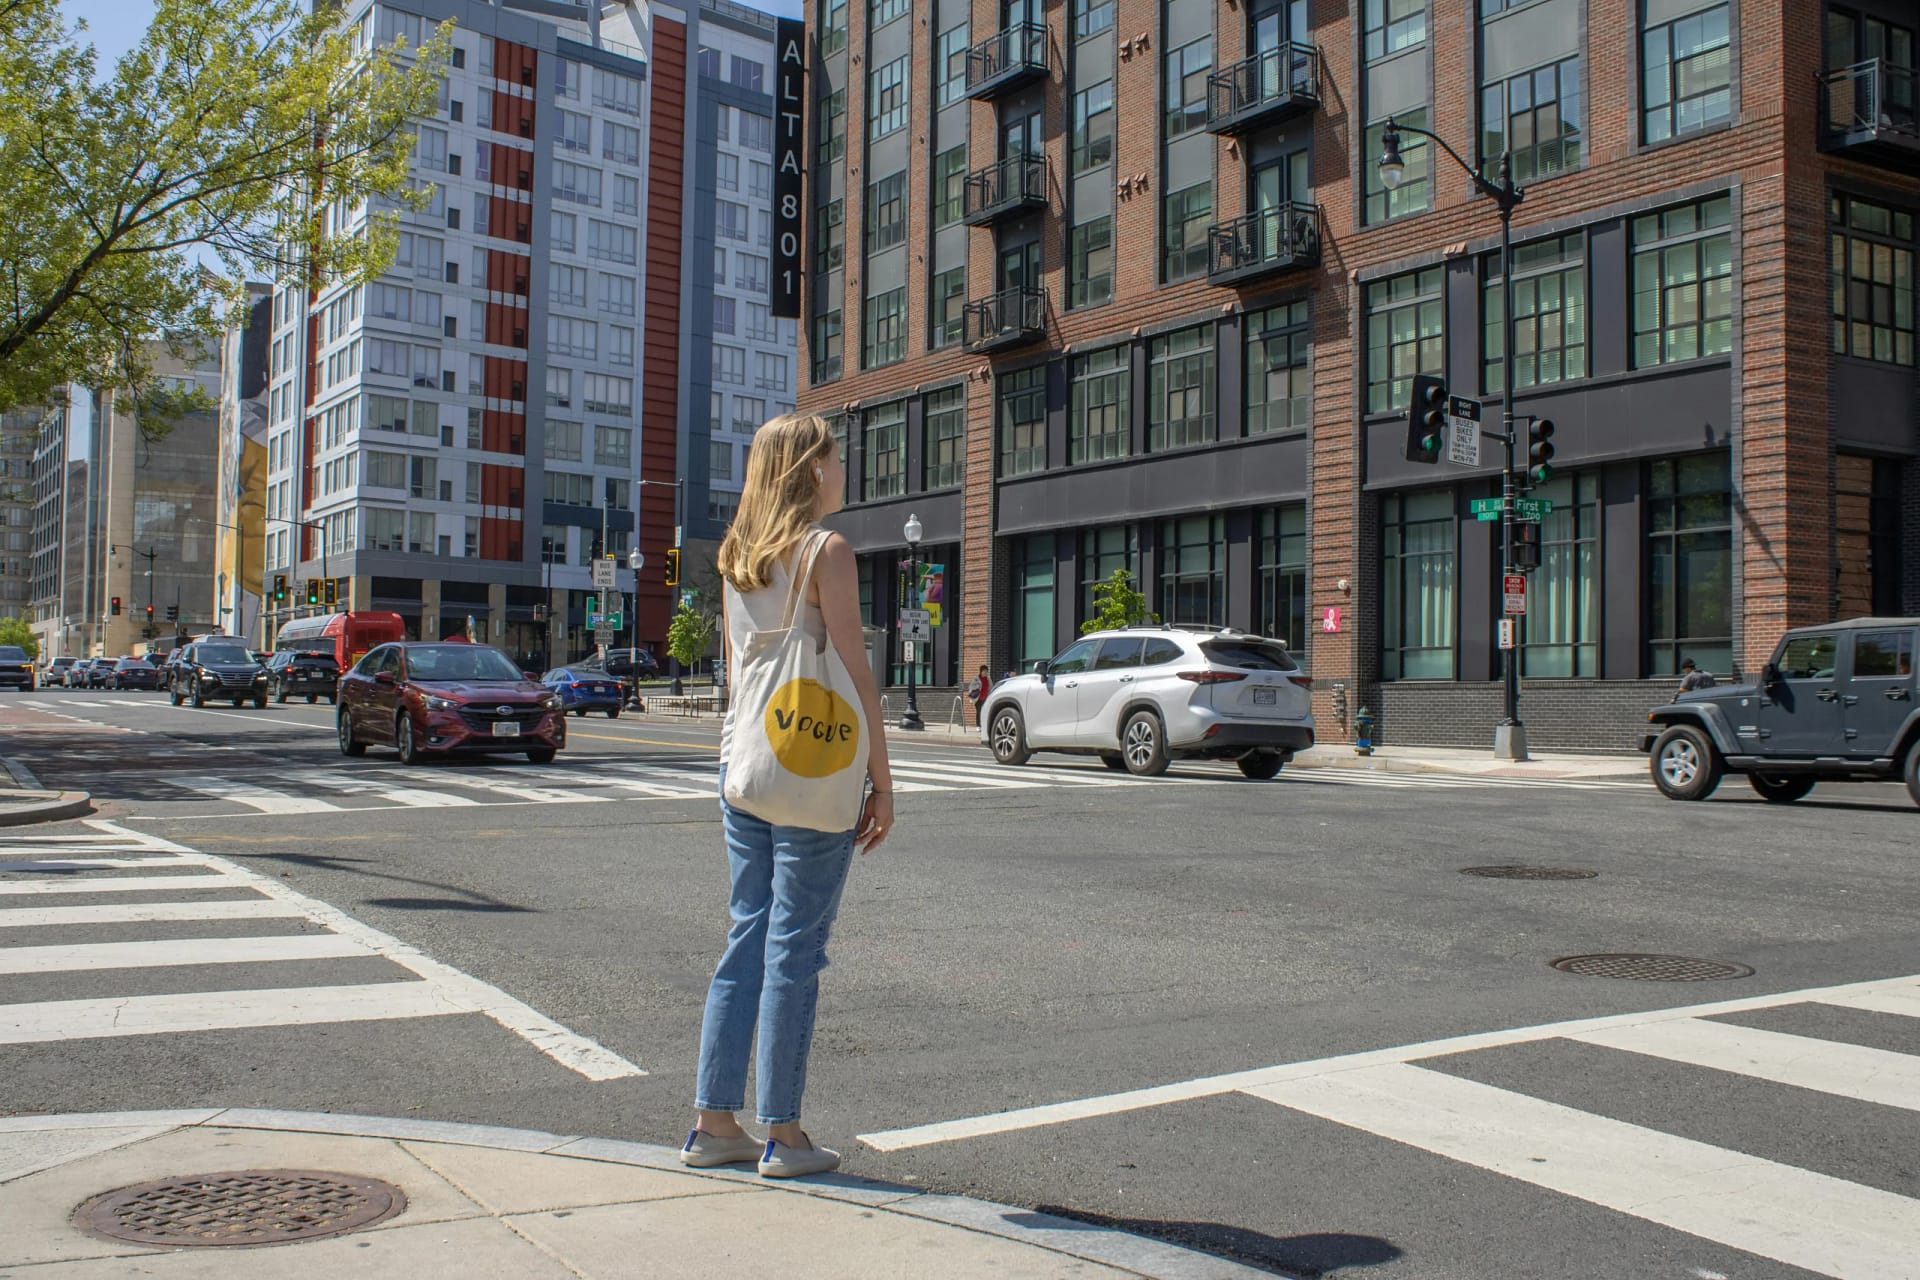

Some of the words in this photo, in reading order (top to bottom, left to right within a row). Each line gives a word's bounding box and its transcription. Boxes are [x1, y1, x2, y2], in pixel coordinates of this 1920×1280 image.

[780, 39, 802, 175] ALTA
[780, 194, 798, 295] 801
[1458, 409, 1472, 418] LANE
[1455, 418, 1474, 428] BUSES
[1455, 426, 1473, 437] BIKES
[1456, 434, 1473, 445] ONLY
[1478, 501, 1486, 512] H
[1516, 500, 1539, 512] First
[1526, 512, 1541, 520] 700
